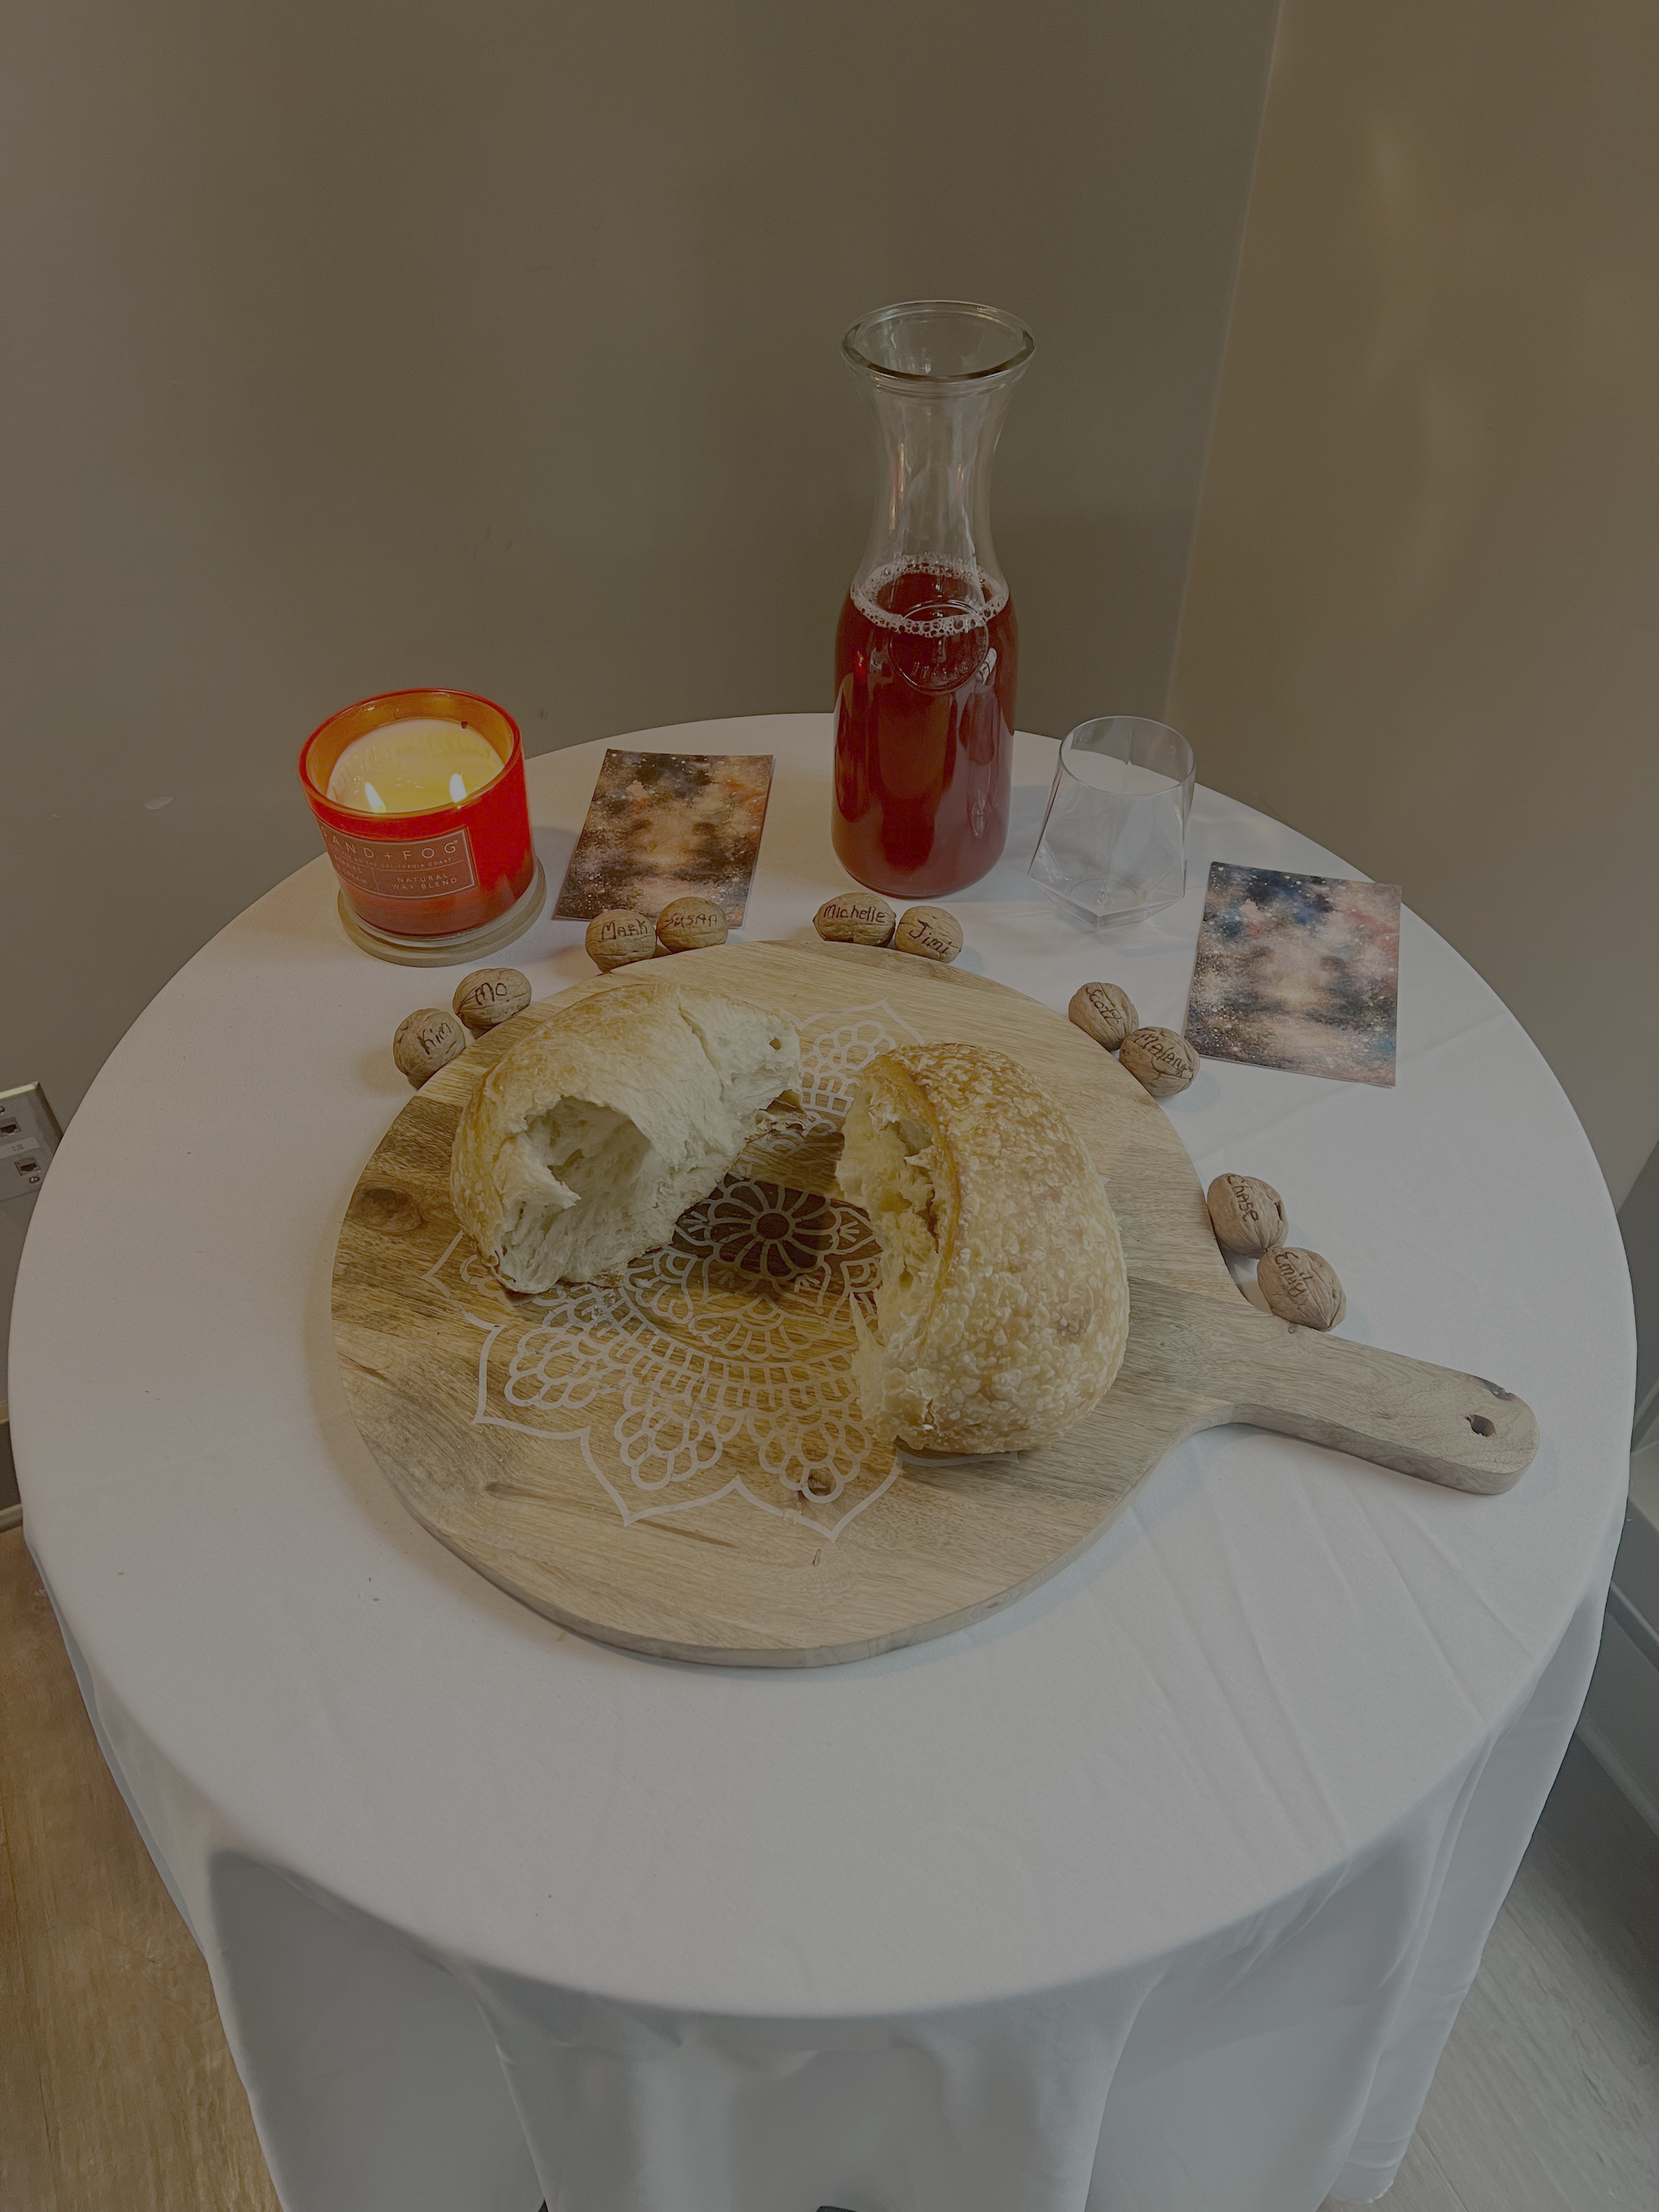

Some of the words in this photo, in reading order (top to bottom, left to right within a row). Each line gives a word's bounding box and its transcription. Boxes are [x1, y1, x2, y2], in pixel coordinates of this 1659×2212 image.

[428, 857, 451, 866] COAST
[397, 873, 449, 883] NATURAL
[421, 877, 457, 889] BLEND
